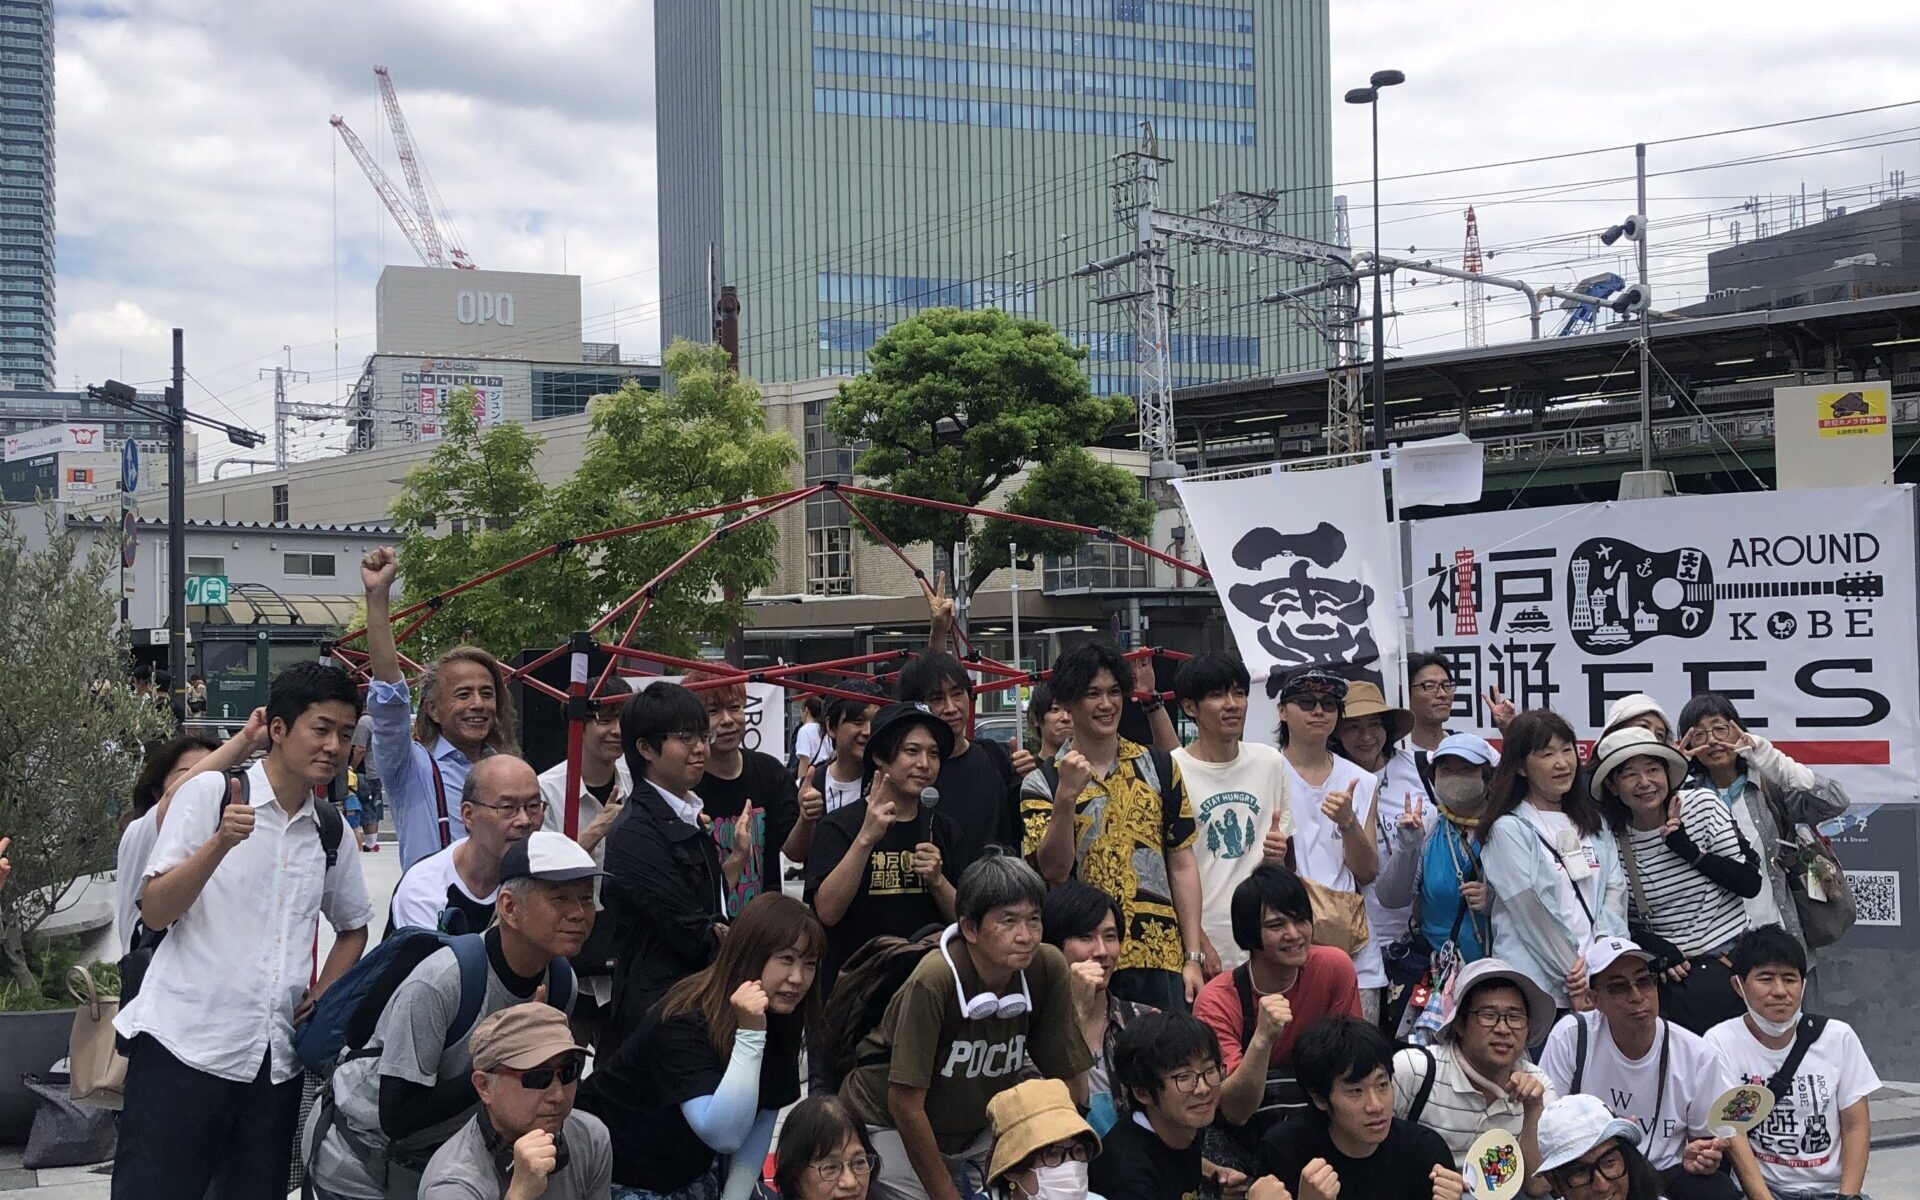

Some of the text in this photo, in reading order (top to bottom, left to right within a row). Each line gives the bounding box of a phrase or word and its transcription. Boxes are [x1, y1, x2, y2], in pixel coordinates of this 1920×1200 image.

[1727, 532, 1880, 569] AROUND
[1427, 546, 1557, 637] 神戸
[1729, 609, 1874, 641] KOBE
[1581, 658, 1891, 728] FES
[1203, 793, 1255, 812] STAY HUNGRY
[871, 851, 900, 870] 神戸
[870, 870, 901, 889] 周遊
[1797, 1075, 1810, 1107] KOBE
